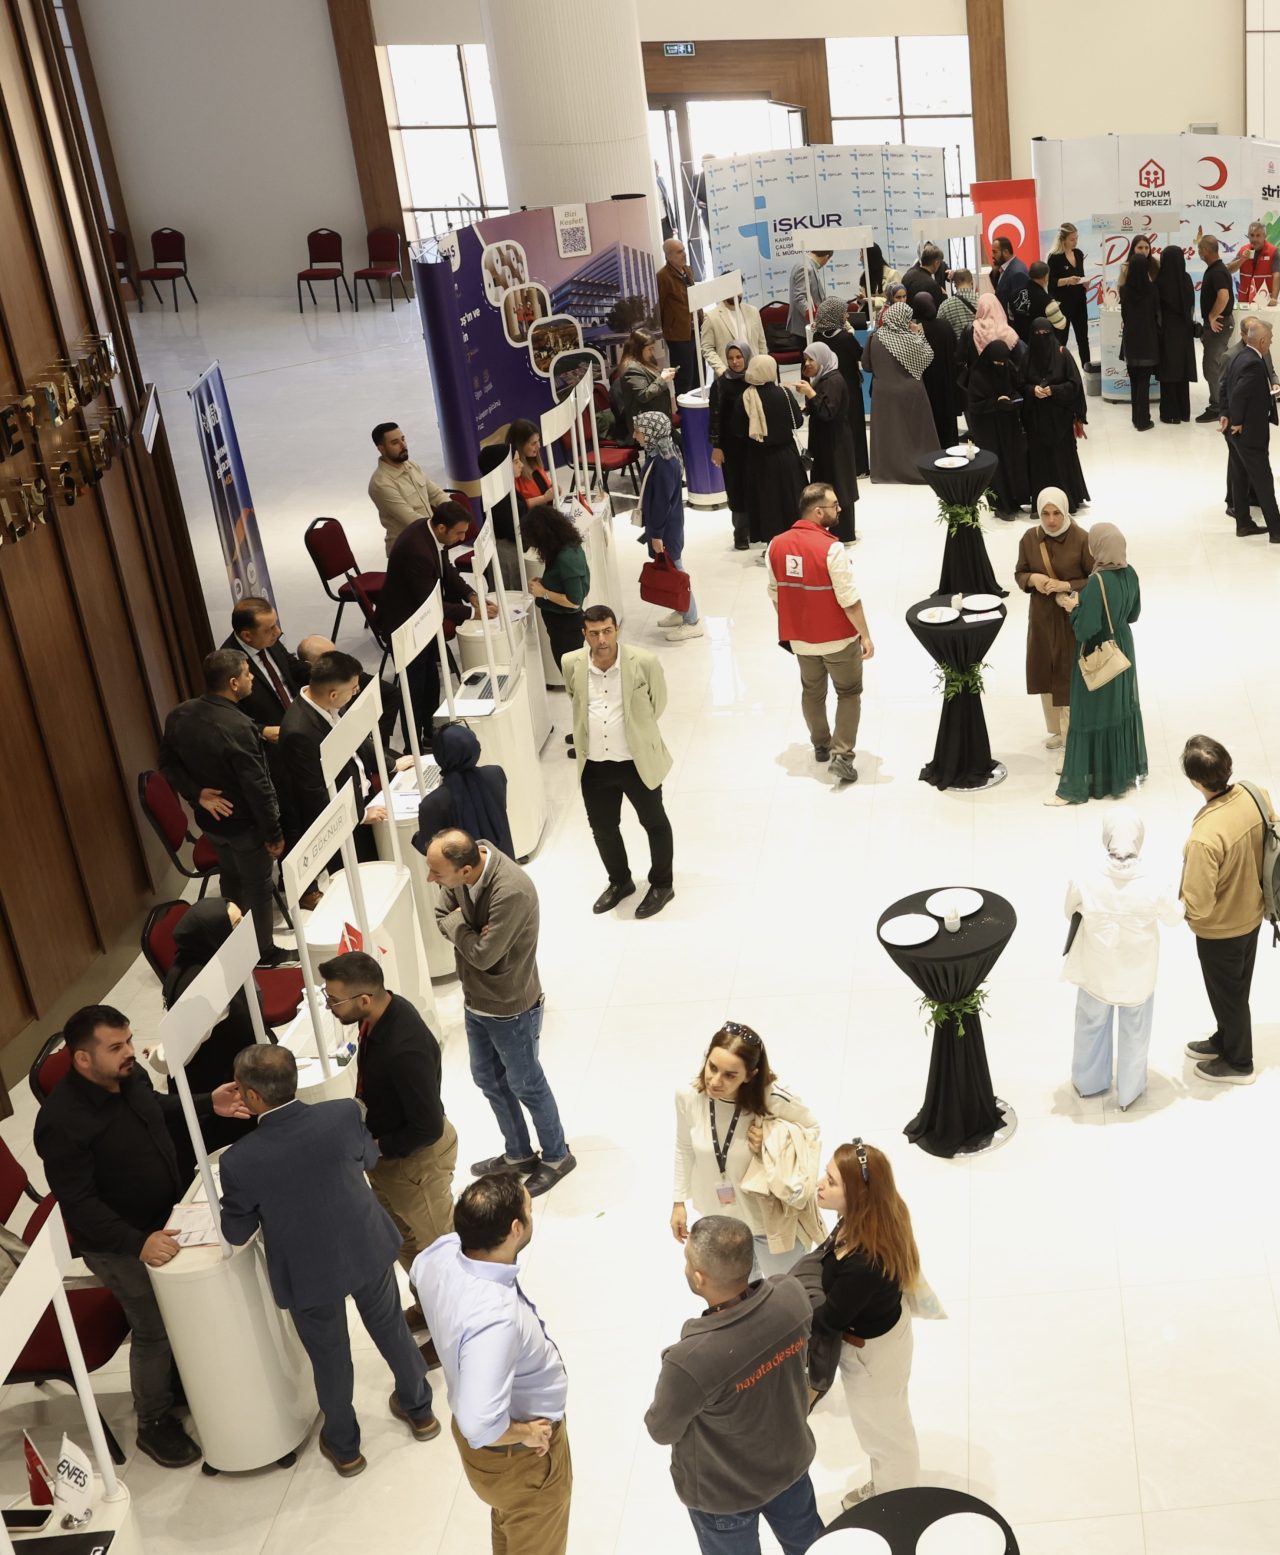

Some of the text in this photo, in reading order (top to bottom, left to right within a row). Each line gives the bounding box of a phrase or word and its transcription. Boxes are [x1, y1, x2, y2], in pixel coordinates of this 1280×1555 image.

[1134, 190, 1171, 198] TOPLUM
[1133, 198, 1172, 207] MERKEZİ
[1196, 199, 1228, 208] KIZILAY
[56, 1458, 89, 1488] ENFES
